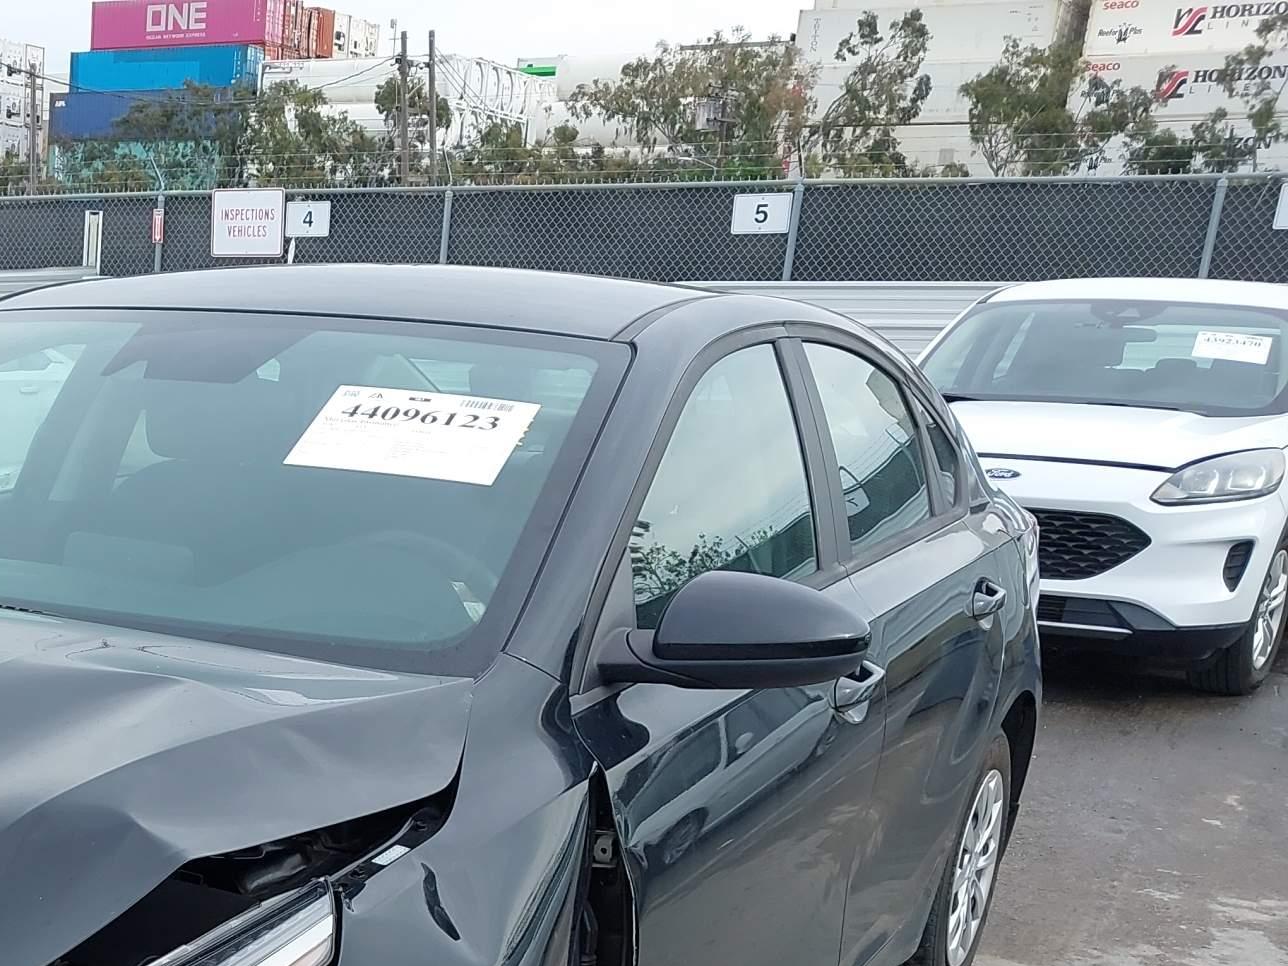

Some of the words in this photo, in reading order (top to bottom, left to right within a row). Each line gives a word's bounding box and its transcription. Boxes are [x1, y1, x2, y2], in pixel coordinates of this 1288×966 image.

[1103, 0, 1140, 10] seaco
[146, 2, 207, 32] ONE
[221, 208, 275, 221] INSPECTIONS
[302, 210, 314, 227] 4
[754, 203, 769, 223] 5
[227, 225, 267, 237] VEHICLES
[341, 403, 500, 430] 44096123
